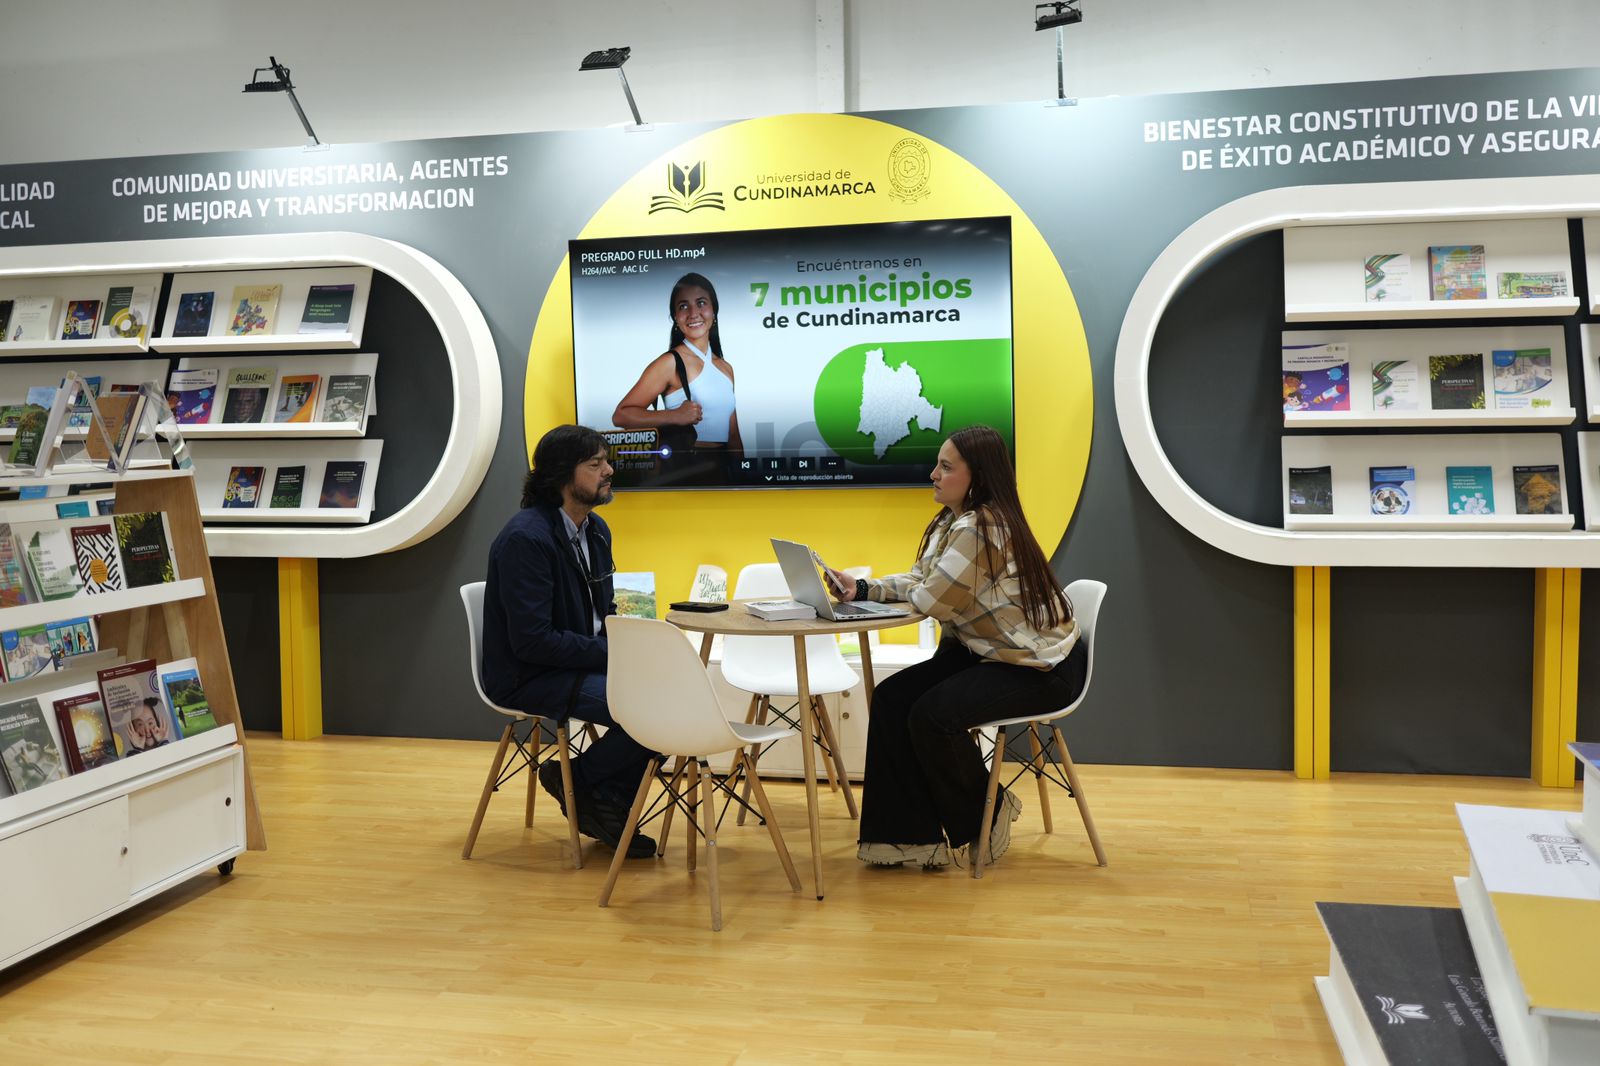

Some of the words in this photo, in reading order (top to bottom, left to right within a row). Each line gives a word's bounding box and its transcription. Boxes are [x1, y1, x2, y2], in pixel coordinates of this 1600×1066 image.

[1143, 113, 1283, 143] BIENESTAR
[1289, 100, 1479, 133] CONSTITUTIVO
[1486, 99, 1519, 122] DE
[1527, 96, 1561, 120] LA
[1182, 148, 1213, 171] DE
[1219, 142, 1292, 170] ÉXITO
[1299, 132, 1451, 164] ACADÉMICO
[1457, 134, 1475, 155] Y
[112, 171, 231, 197] COMUNIDAD
[236, 161, 404, 190] UNIVERSITARIA,
[410, 155, 509, 180] AGENTES
[757, 170, 831, 185] Universidad
[834, 169, 851, 180] de
[0, 181, 55, 201] LIDAD
[733, 181, 876, 202] CUNDINAMARCA
[144, 203, 167, 223] DE
[173, 198, 252, 225] MEJORA
[256, 198, 271, 218] Y
[274, 188, 475, 217] TRANSFORMACION
[0, 210, 35, 230] CAL
[581, 251, 635, 263] PREGRADO
[638, 249, 663, 260] FULL
[665, 247, 706, 259] HD.mp4
[796, 258, 899, 273] Encuéntranos
[903, 257, 922, 267] en
[581, 266, 616, 276] H264/AVC
[622, 265, 637, 273] AAC
[639, 264, 649, 273] LC
[750, 282, 770, 307] 7
[780, 271, 973, 307] municipios
[762, 312, 789, 329] de
[796, 307, 961, 328] Cundinamarca
[799, 474, 834, 482] reproducción
